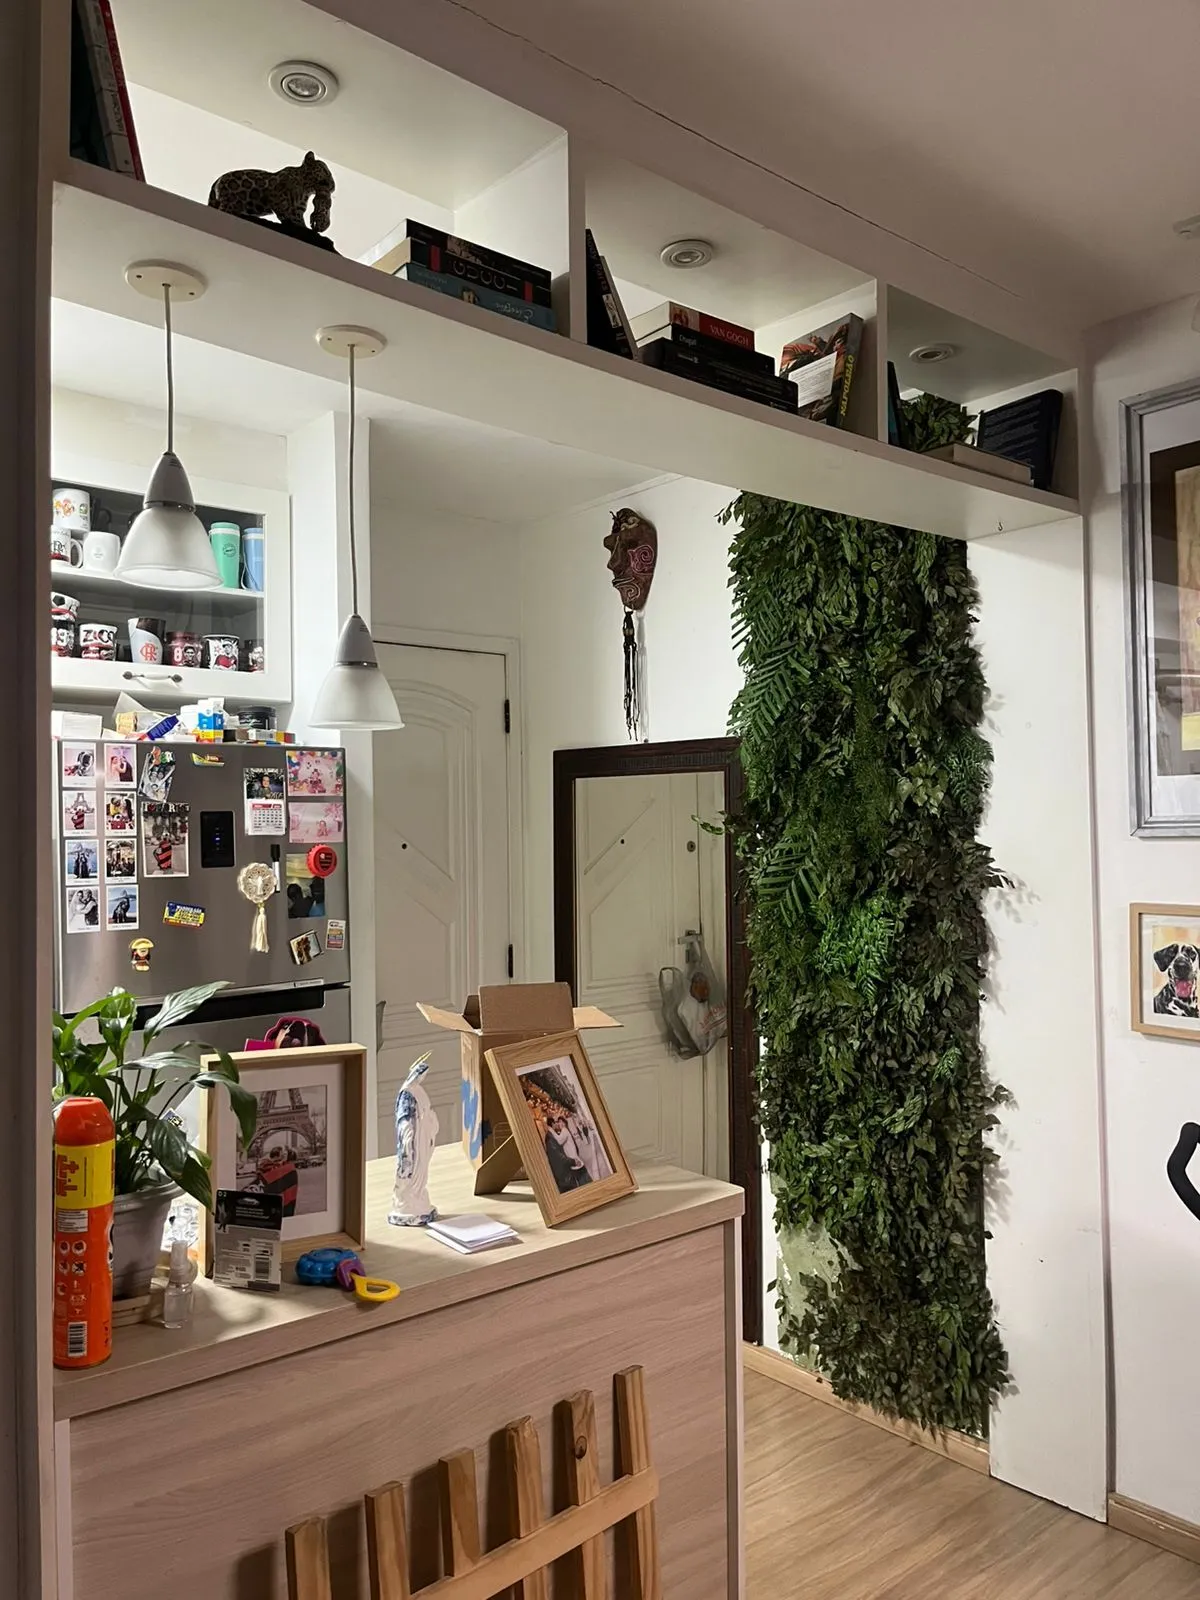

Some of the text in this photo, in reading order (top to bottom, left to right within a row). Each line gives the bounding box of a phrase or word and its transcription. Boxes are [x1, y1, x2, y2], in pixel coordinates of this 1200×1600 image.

[452, 260, 518, 292] GUCCI
[709, 324, 749, 346] VAN GOGH
